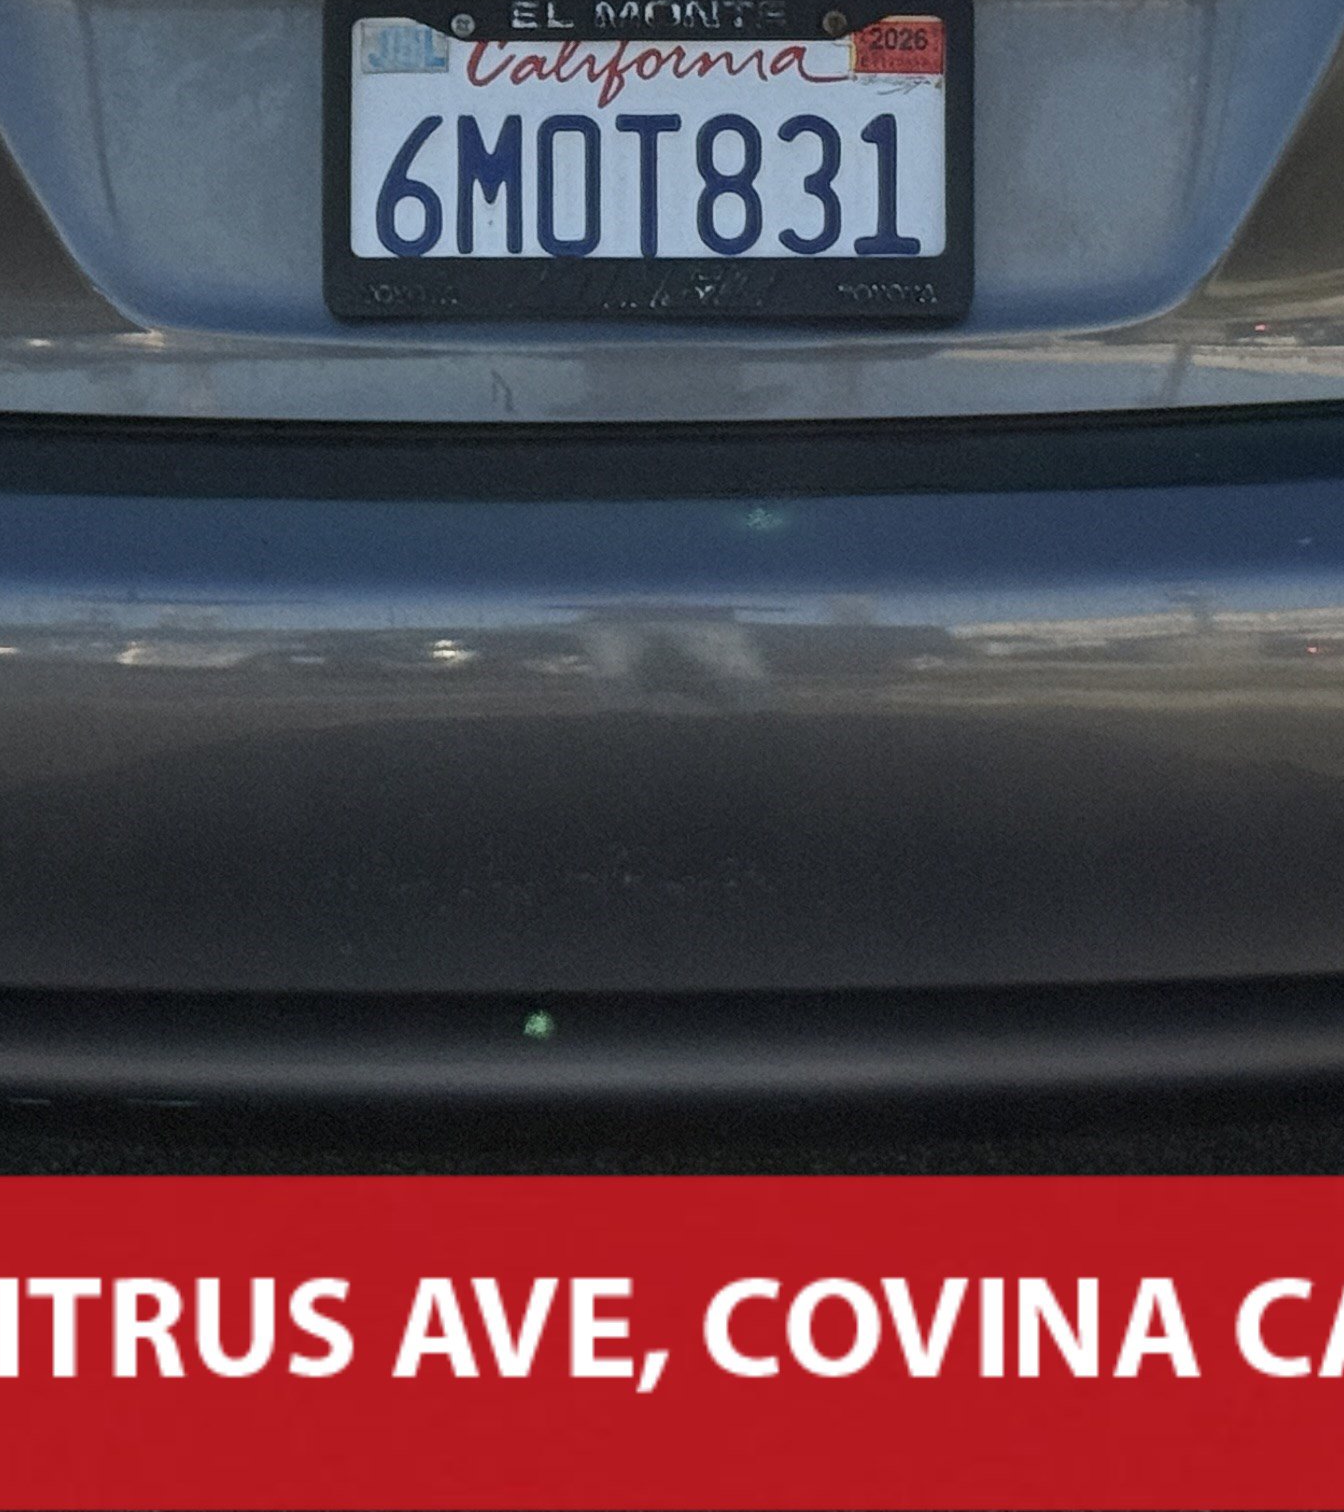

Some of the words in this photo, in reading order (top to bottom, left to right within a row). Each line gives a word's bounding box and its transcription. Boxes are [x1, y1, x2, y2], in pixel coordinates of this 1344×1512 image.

[511, 0, 575, 29] EL
[594, 0, 787, 29] MONTE
[869, 27, 929, 51] 2026
[466, 39, 854, 109] California
[375, 112, 921, 257] 6MOT831
